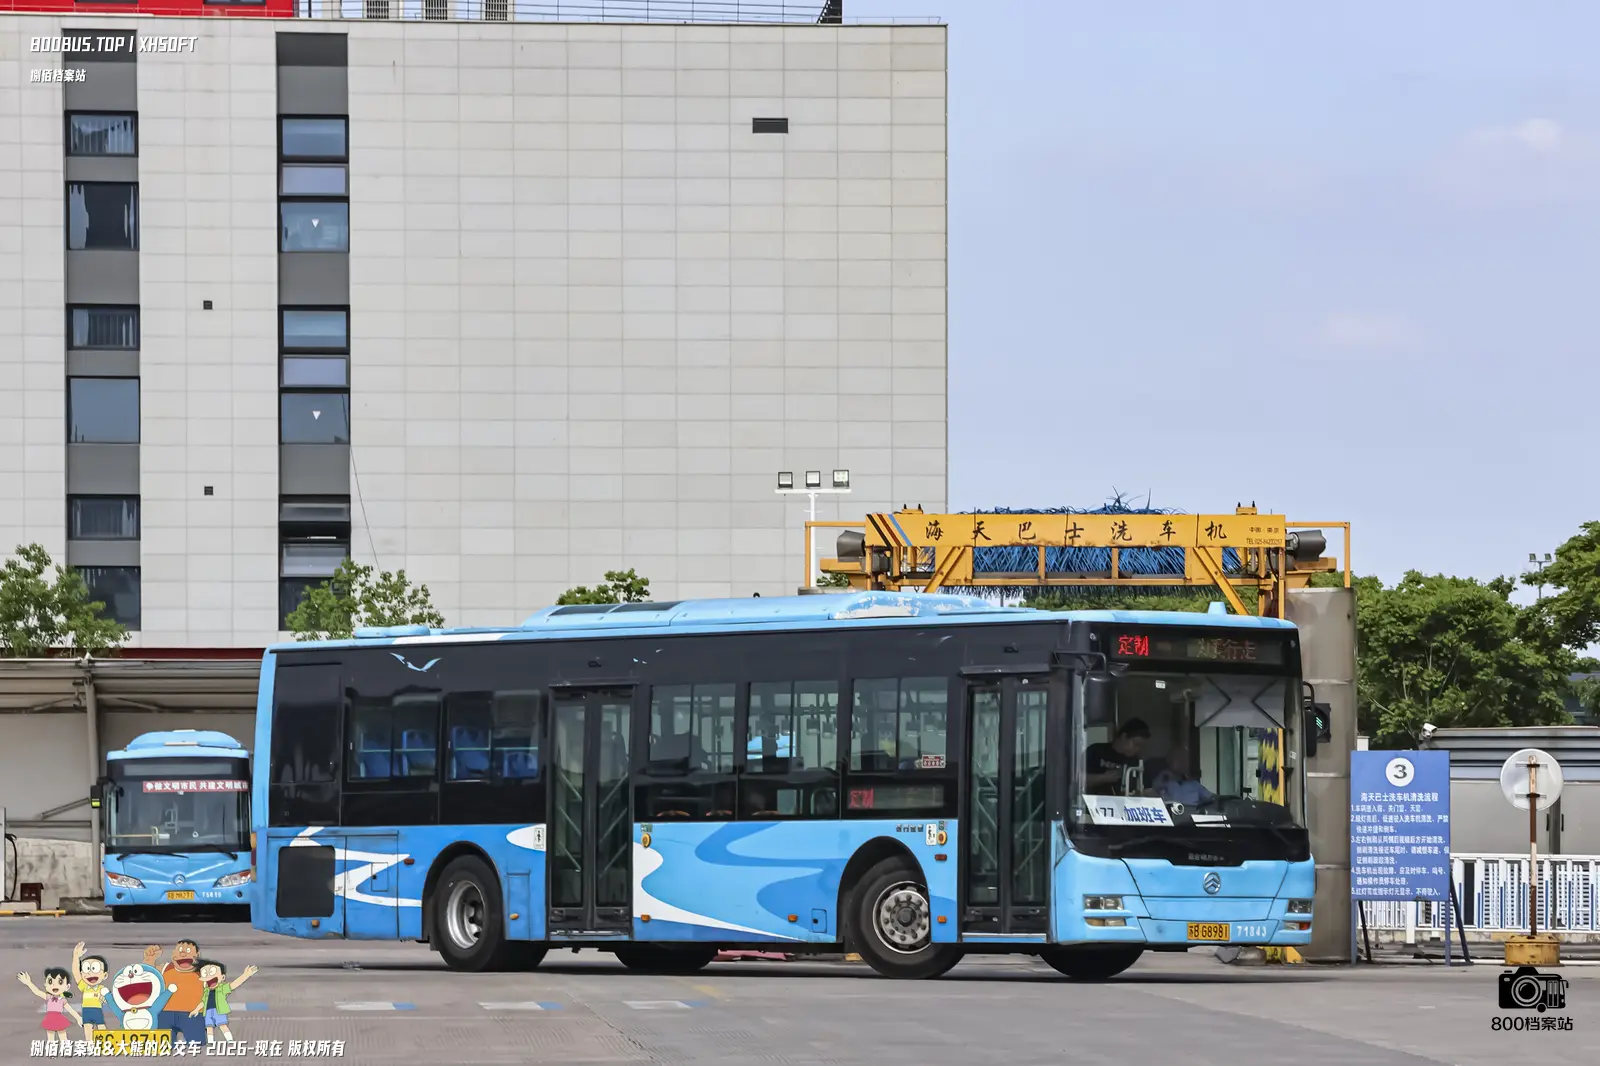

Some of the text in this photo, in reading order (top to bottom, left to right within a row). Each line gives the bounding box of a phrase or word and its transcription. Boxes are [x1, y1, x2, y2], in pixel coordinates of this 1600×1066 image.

[925, 520, 1228, 542] 海天巴士洗车机
[1117, 634, 1149, 657] 定制
[1393, 764, 1408, 779] 3
[1123, 806, 1167, 823] 加班车
[1236, 925, 1267, 937] 71843
